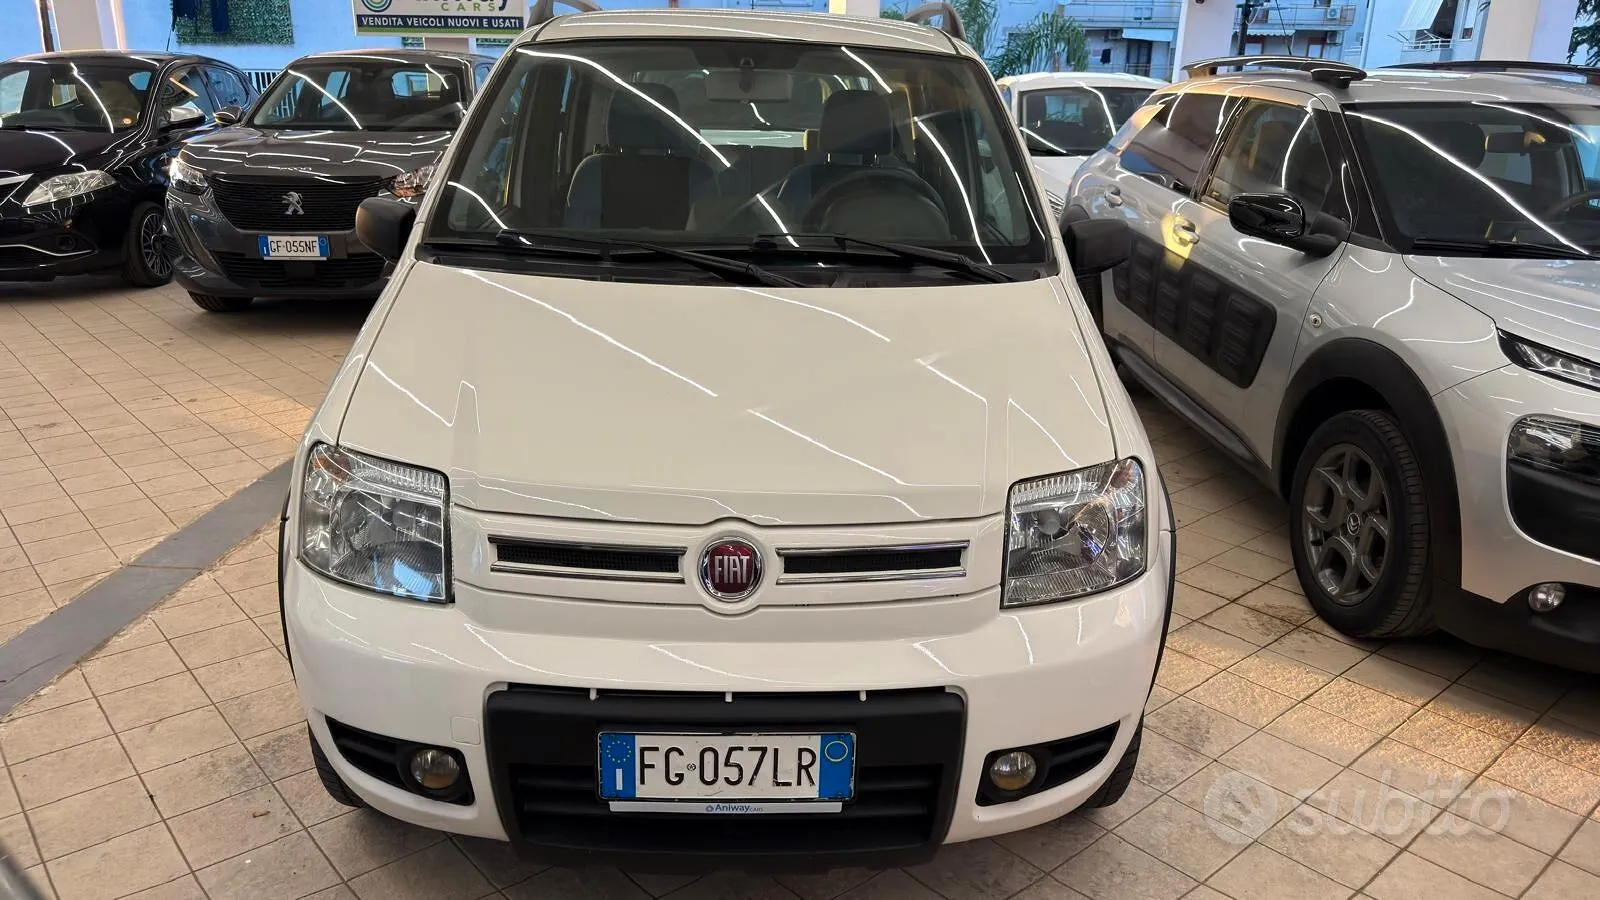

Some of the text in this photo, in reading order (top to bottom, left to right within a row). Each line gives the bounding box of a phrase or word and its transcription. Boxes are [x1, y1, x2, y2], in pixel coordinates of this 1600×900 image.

[441, 2, 496, 12] CARS
[362, 16, 519, 28] VENDITA VEICOLI NUOVI E USATI
[714, 555, 750, 584] FIAT
[715, 803, 750, 813] Aniway
